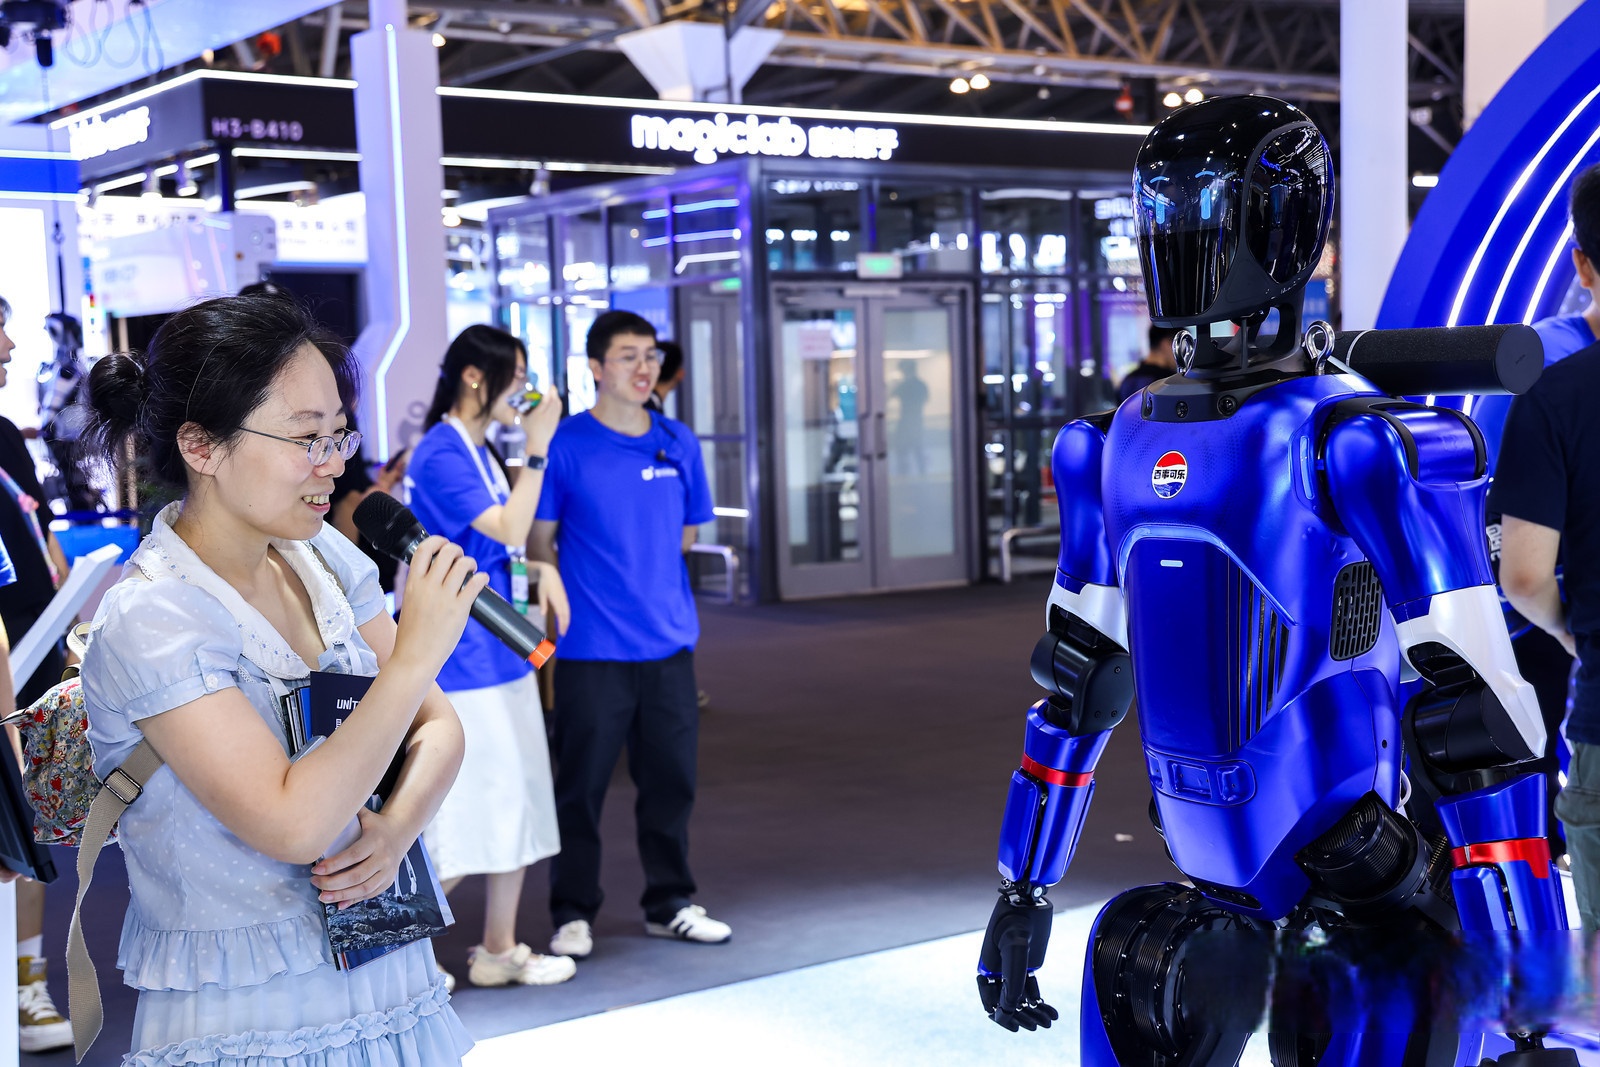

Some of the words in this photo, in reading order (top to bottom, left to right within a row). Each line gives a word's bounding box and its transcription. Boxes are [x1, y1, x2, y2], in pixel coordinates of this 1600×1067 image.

[211, 117, 303, 141] H3-B410
[631, 113, 807, 164] magiclab
[1153, 469, 1186, 480] 百事可乐
[336, 697, 360, 710] UNIT
